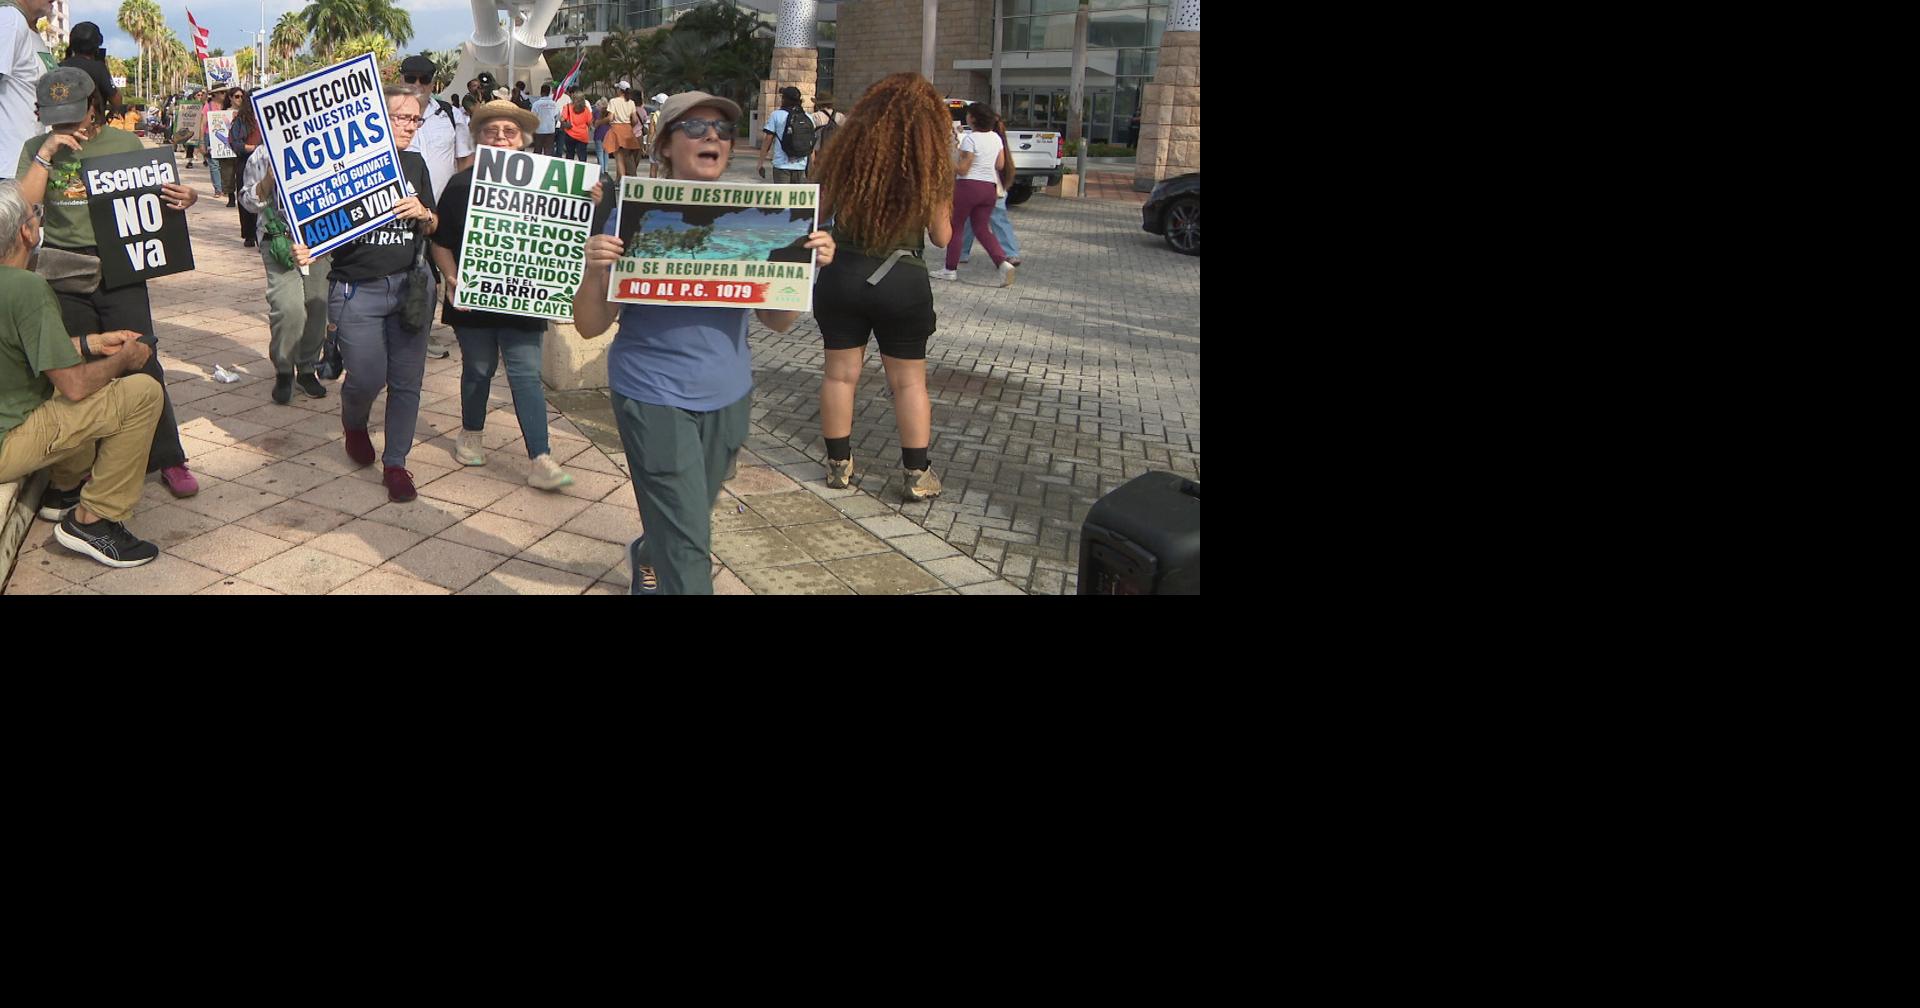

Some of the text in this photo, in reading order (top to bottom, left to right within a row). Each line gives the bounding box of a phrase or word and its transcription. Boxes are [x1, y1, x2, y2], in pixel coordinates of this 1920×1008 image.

[263, 68, 373, 130] PROTECCIÓN
[283, 97, 371, 144] DE NUESTRAS
[283, 113, 384, 181] AGUAS
[87, 160, 175, 195] Esencia
[294, 155, 391, 204] CAYEY, RÍO GUAVATE
[334, 162, 345, 172] EN
[477, 148, 591, 197] NO AL
[306, 171, 386, 214] Y RÍO LA PLATA
[472, 185, 591, 223] DESARROLLO
[624, 184, 816, 205] LO QUE DESTRUYEN HOY
[112, 194, 163, 238] NO
[304, 185, 401, 247] AGUA ES VIDA
[470, 215, 586, 244] TERRENOS
[125, 238, 167, 272] va
[465, 247, 582, 272] ESPECIALMENTE
[467, 228, 585, 260] RÚSTICOS
[463, 259, 580, 285] PROTEGIDOS
[506, 276, 534, 287] EN EL
[616, 260, 809, 279] NO SE RECUPERA MAÑANA.
[460, 291, 574, 316] VEGAS DE CAYEY
[480, 281, 548, 300] BARRIO
[630, 281, 650, 295] NO
[656, 283, 674, 296] AL
[716, 284, 752, 298] 1079
